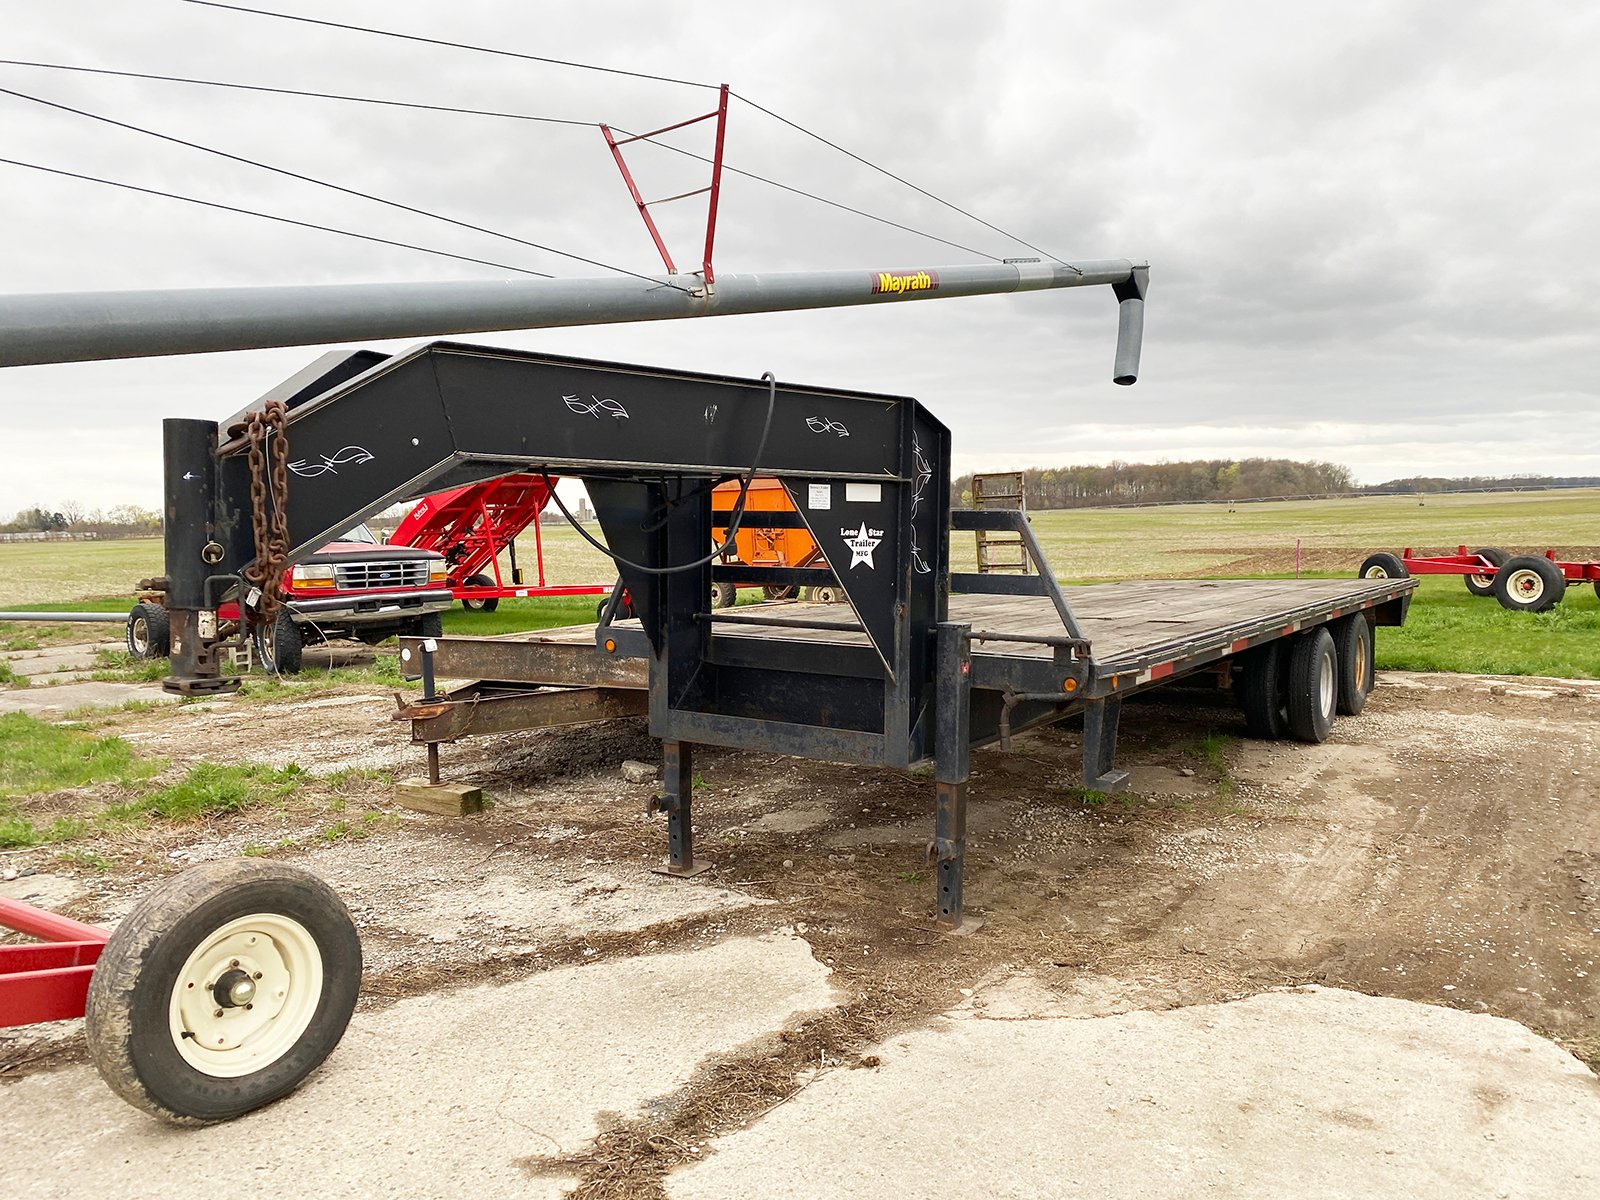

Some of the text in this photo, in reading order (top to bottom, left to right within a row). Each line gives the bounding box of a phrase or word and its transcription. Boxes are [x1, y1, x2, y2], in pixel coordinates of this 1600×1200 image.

[878, 271, 931, 294] Mayrath
[840, 527, 885, 537] Lone Star
[850, 539, 876, 547] Trailer
